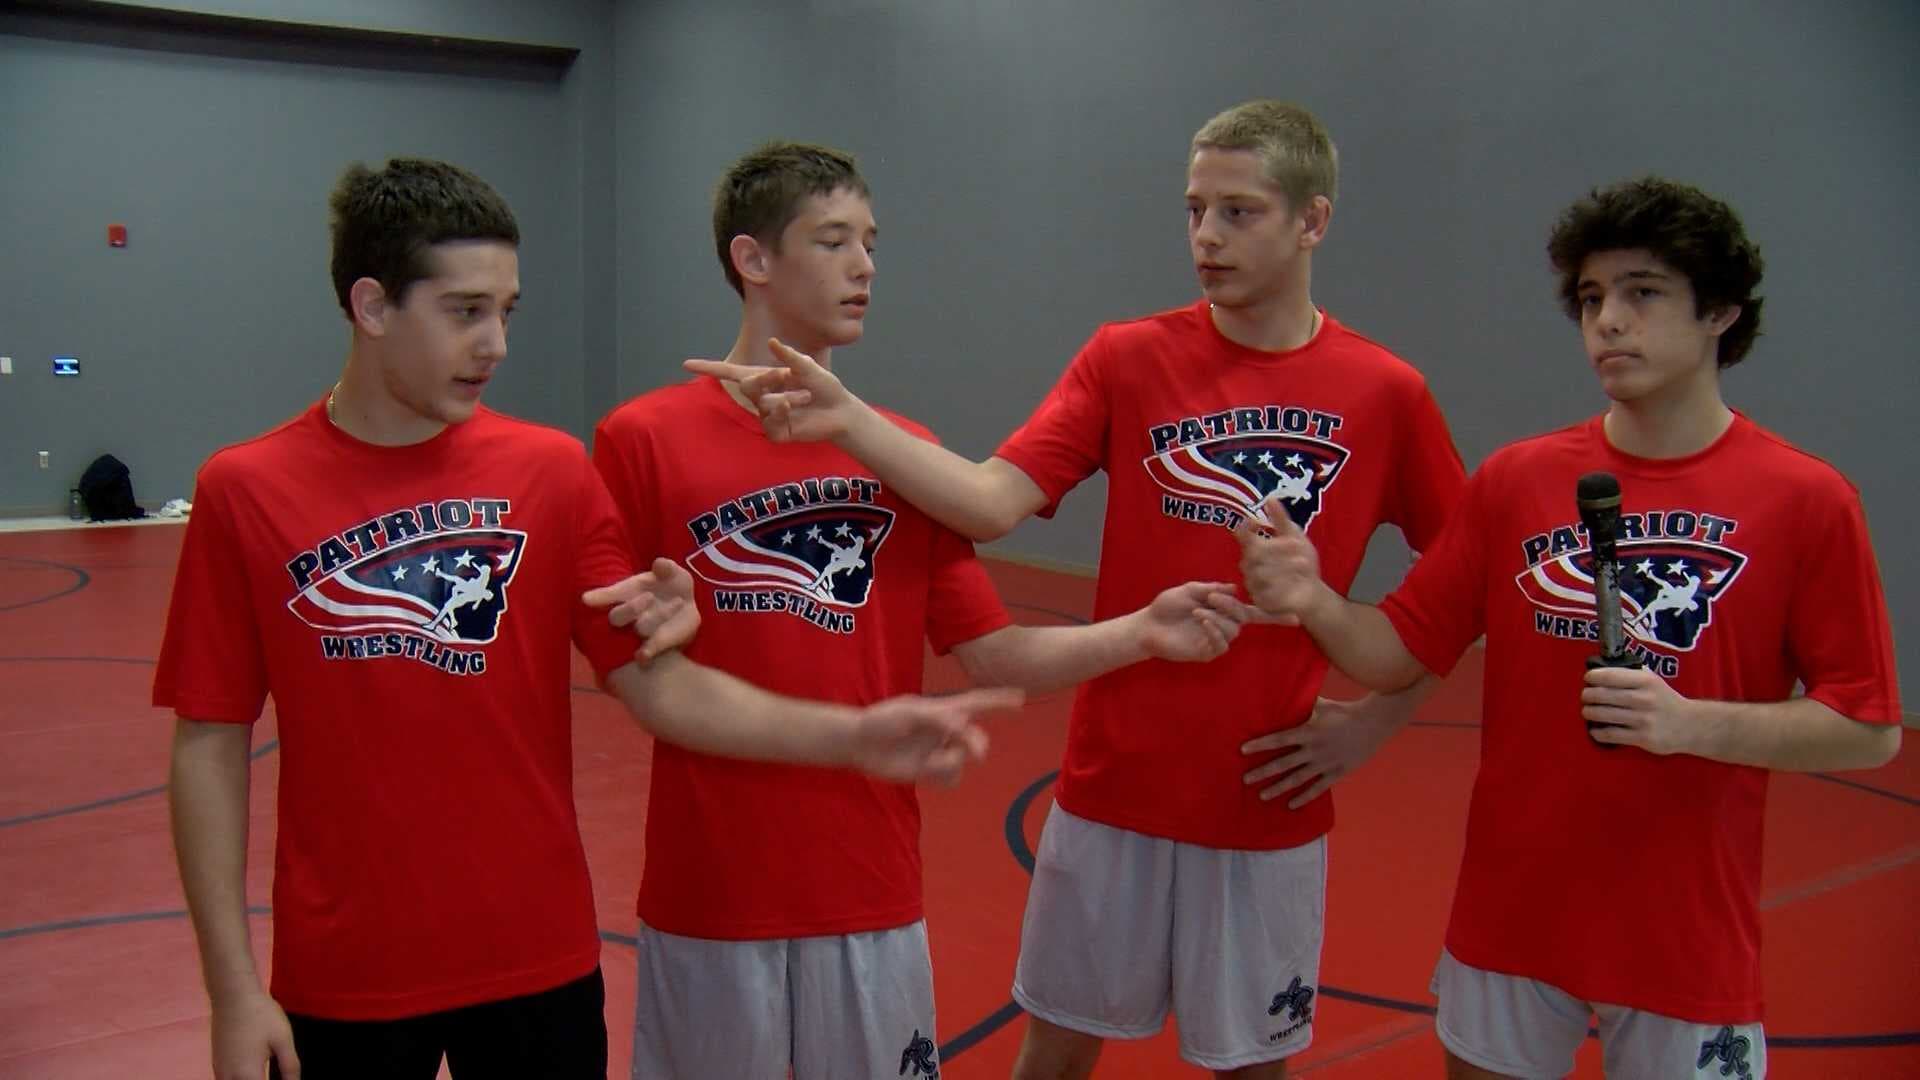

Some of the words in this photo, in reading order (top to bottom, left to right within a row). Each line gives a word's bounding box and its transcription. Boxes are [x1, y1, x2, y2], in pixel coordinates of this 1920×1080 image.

[1149, 405, 1344, 456] PATRIOT
[687, 477, 882, 548] PATRIOT
[1162, 495, 1246, 532] WREST
[286, 498, 511, 593] PATRIOT
[714, 589, 856, 634] WRESTLING
[321, 633, 487, 676] WRESTLING
